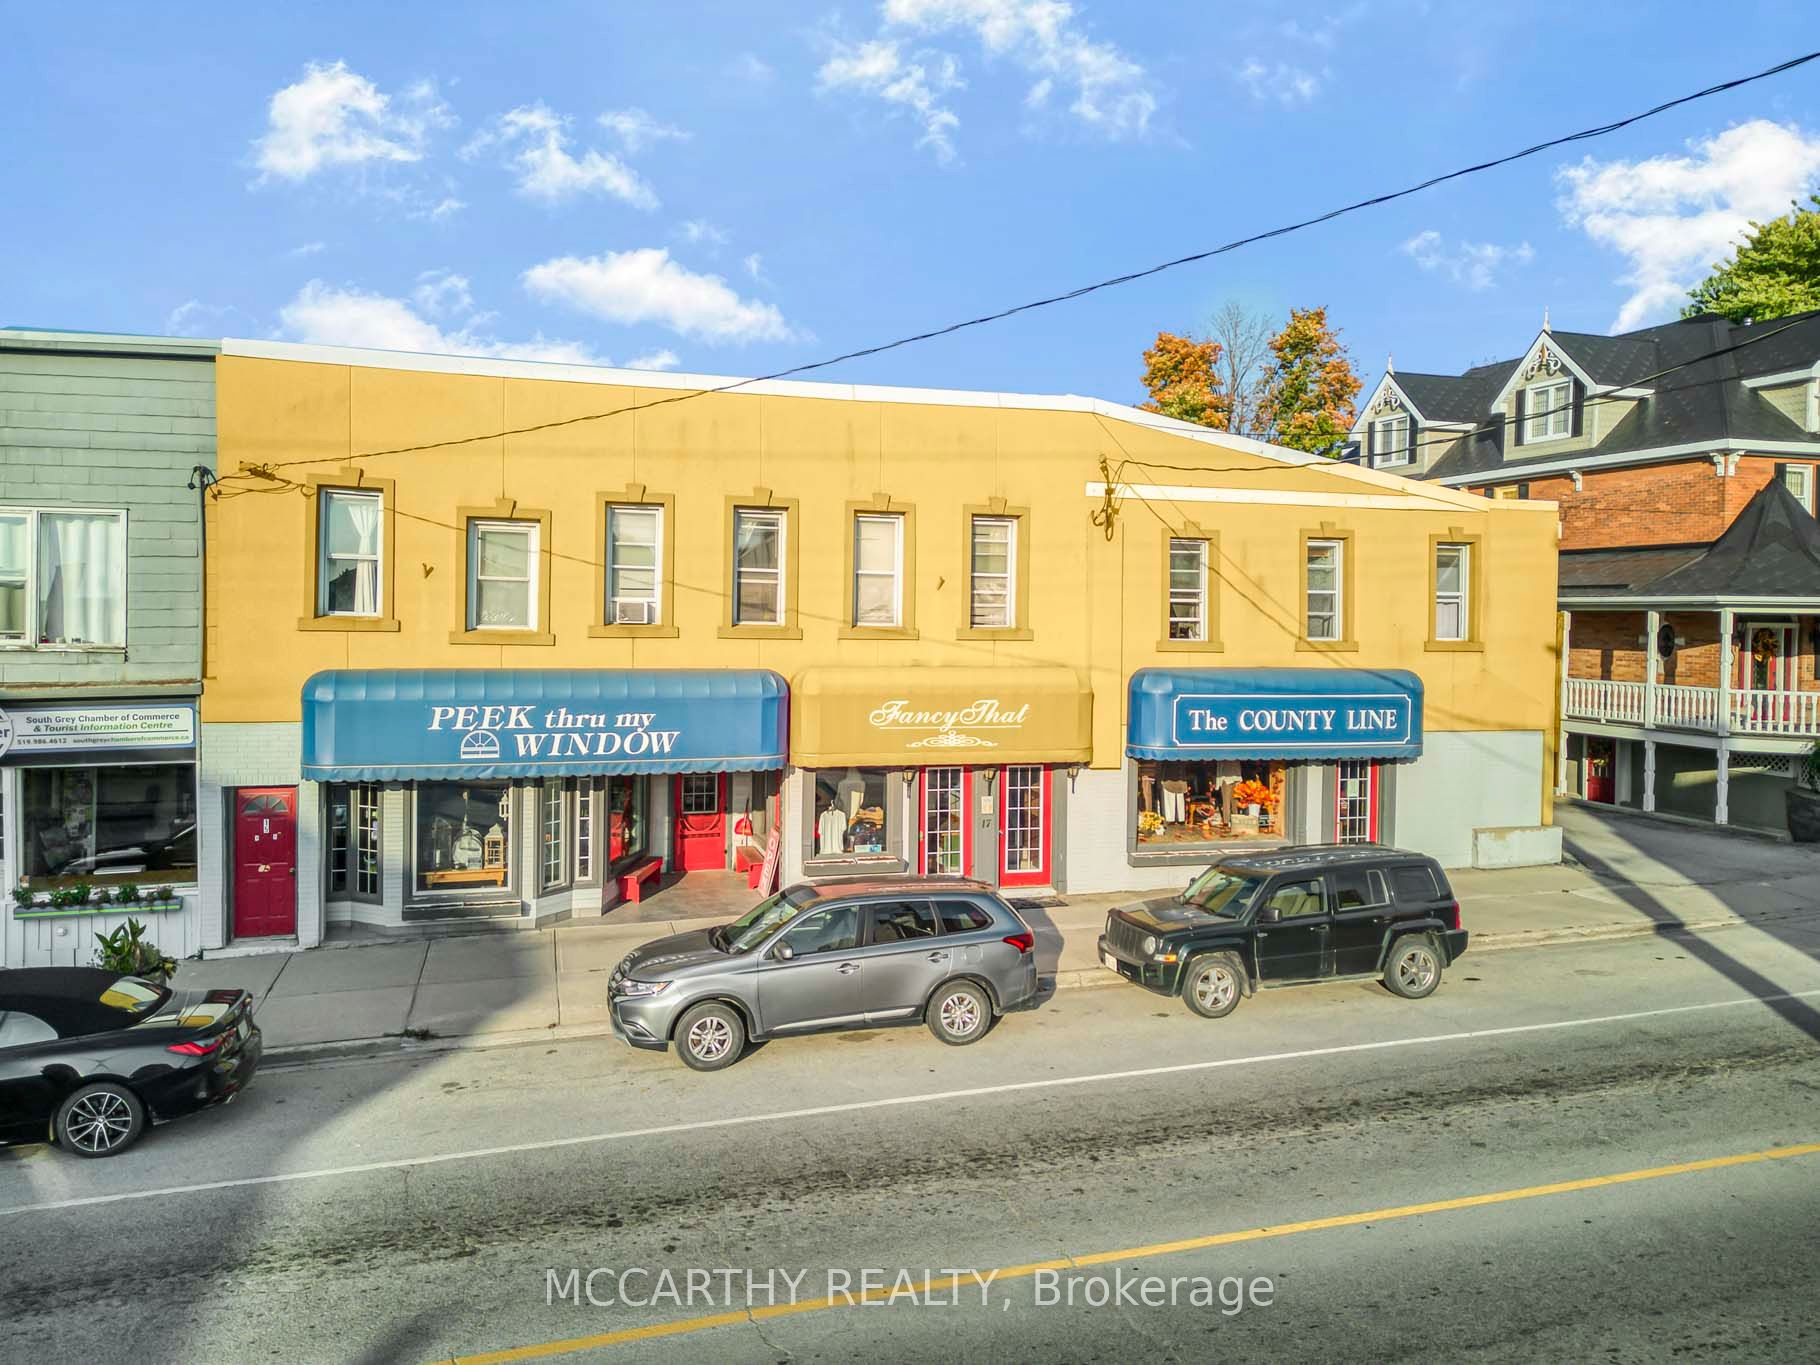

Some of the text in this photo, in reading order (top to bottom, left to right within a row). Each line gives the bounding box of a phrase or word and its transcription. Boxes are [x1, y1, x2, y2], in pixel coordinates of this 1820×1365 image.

[25, 713, 180, 724] South Grey Chamber of Commerce
[44, 724, 78, 732] Tourist
[80, 722, 138, 731] Information
[140, 721, 174, 729] Centre
[427, 705, 656, 732] PEEK thru my
[869, 699, 1030, 732] Fancy That
[1189, 709, 1398, 731] The COUNTY LINE
[514, 730, 681, 757] WINDOW
[982, 819, 992, 828] 17
